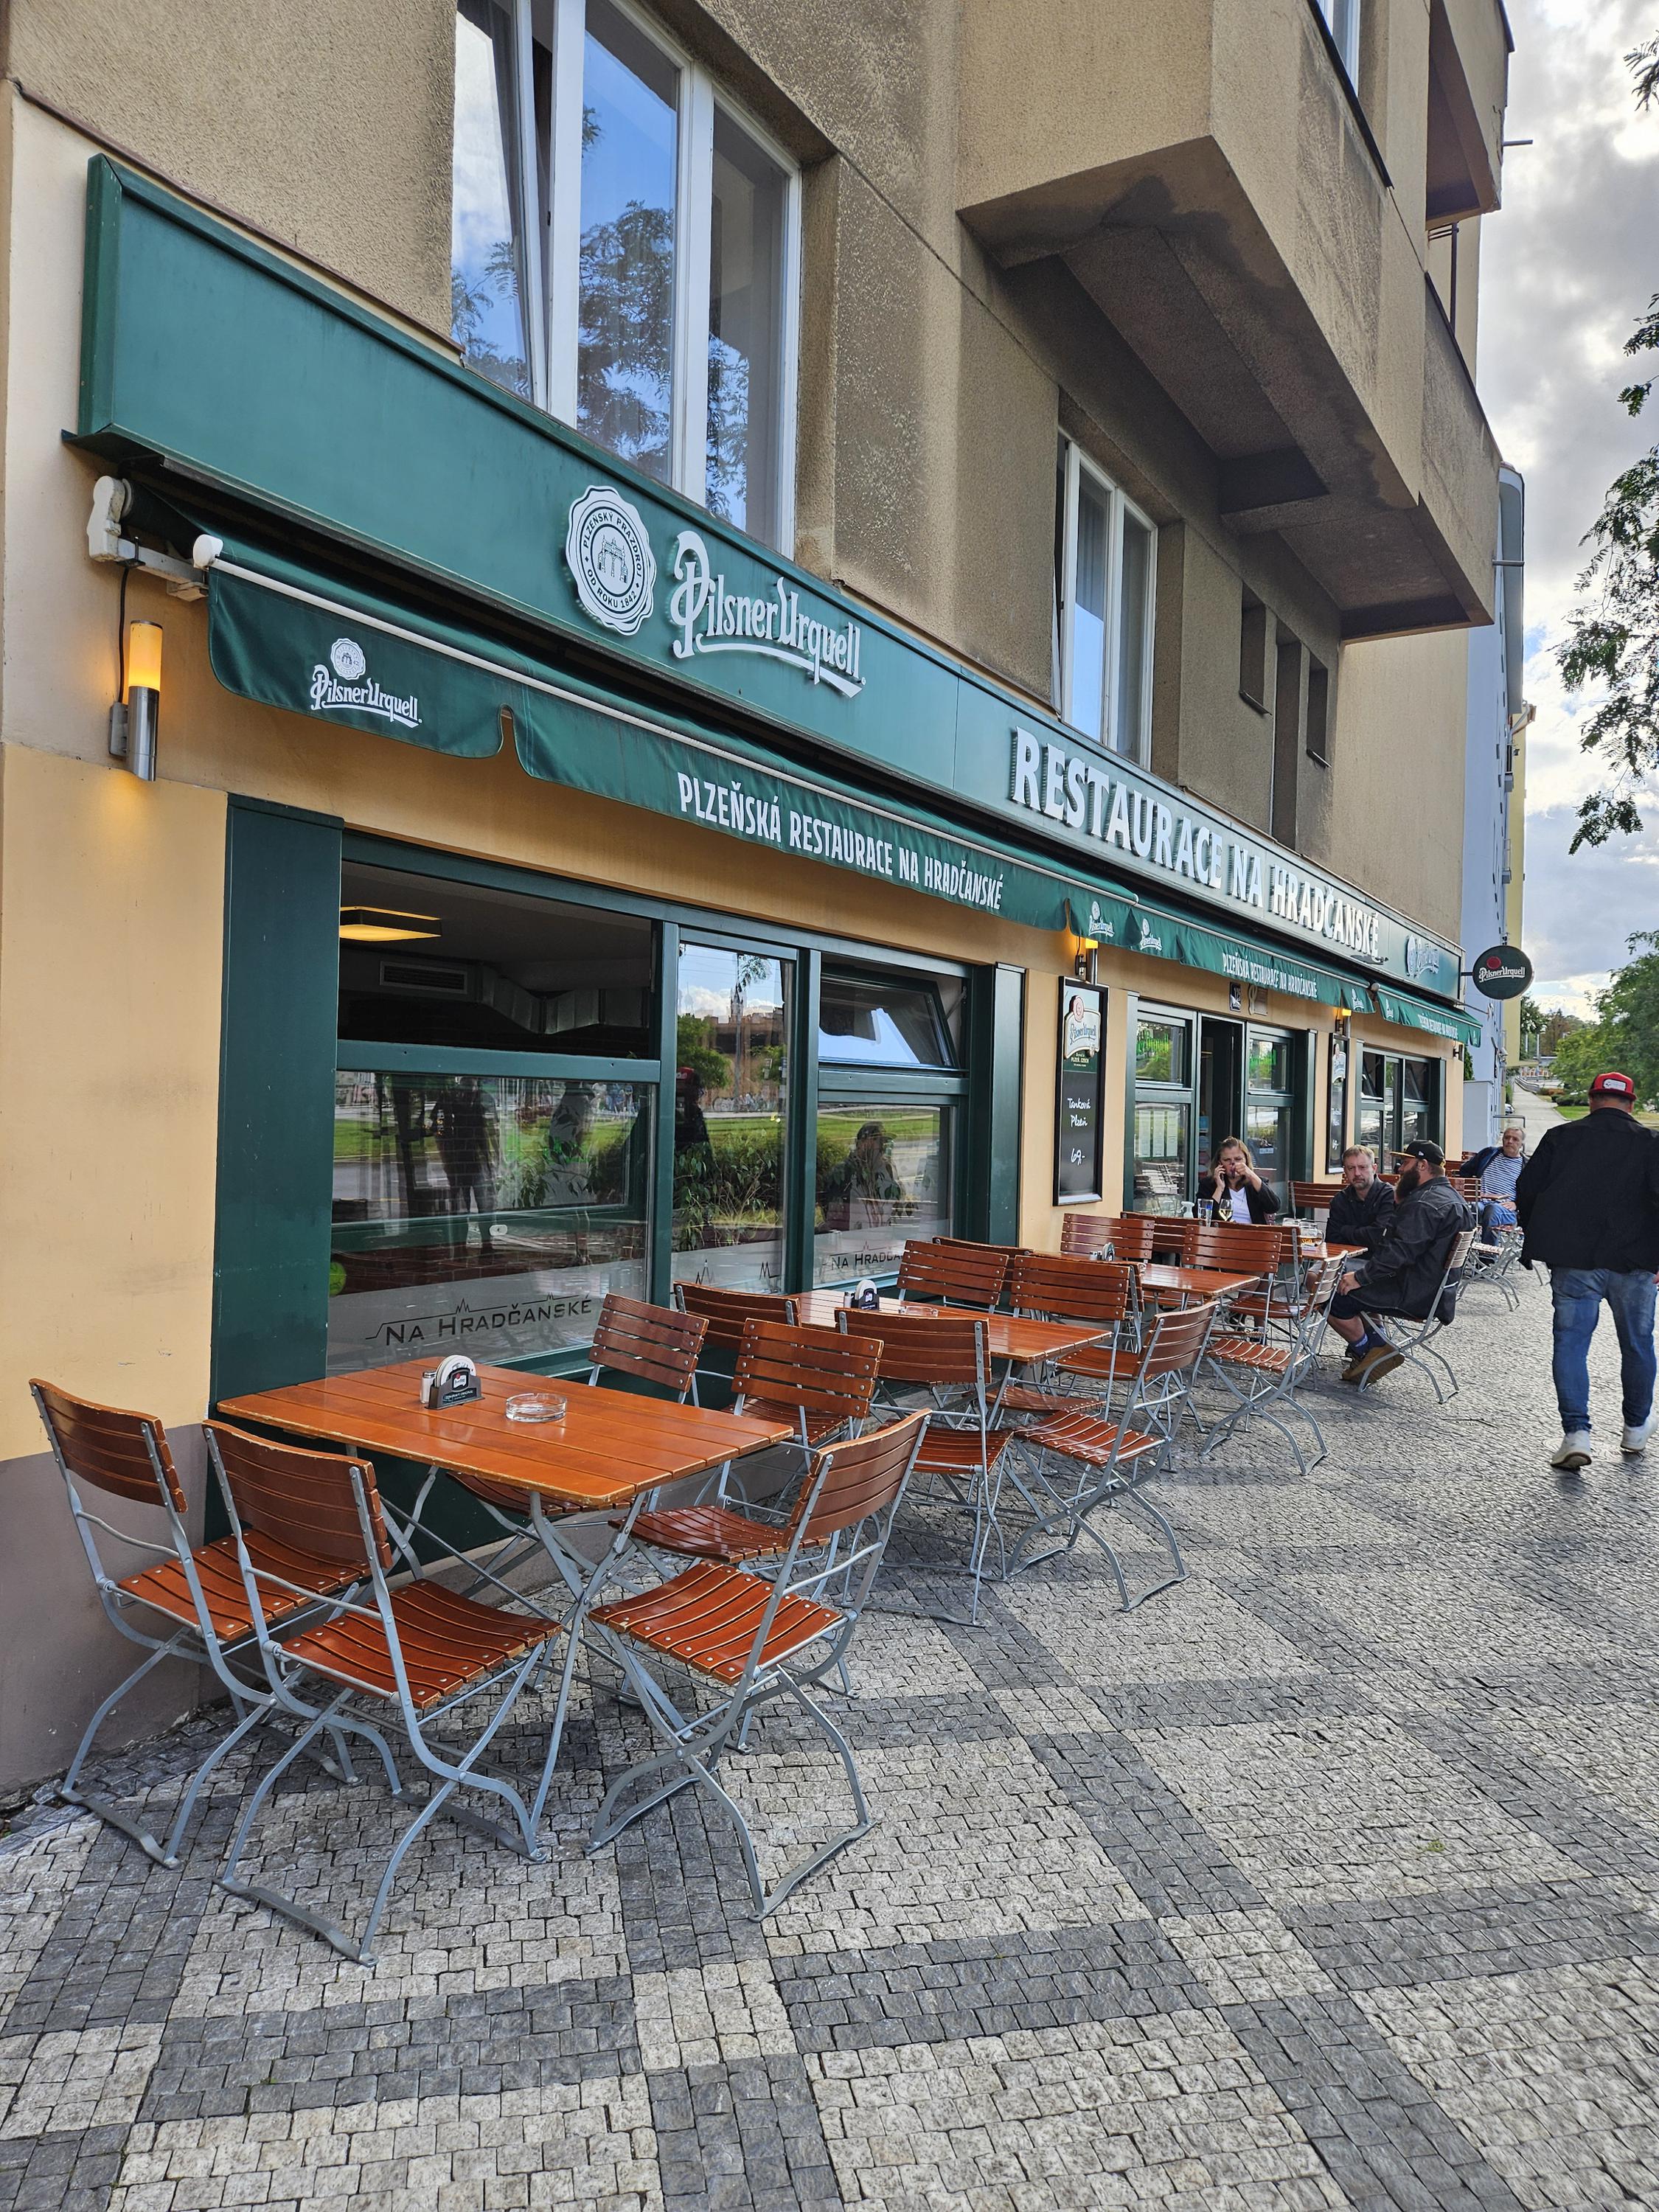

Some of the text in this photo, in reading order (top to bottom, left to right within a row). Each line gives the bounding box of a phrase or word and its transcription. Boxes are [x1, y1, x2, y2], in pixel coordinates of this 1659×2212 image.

[582, 511, 642, 577] PLZEŇSKÝ PRAZDROJ
[587, 568, 637, 608] OD ROKU 1842
[669, 530, 863, 684] Pilsner Urquell
[310, 664, 418, 723] Pilsner Urquell
[677, 771, 1004, 911] PLZEŇSKÁ RESTAURACE NA HRADČANSKÉ
[1012, 726, 1222, 890] RESTAURACE
[1231, 843, 1264, 908] NA
[1272, 864, 1379, 958] HRADČANSKÉ
[1279, 971, 1287, 990] NA
[1478, 966, 1526, 983] Pilsner Urquell
[1067, 1097, 1091, 1110] Tanková
[1070, 1114, 1088, 1127] Plzeň
[831, 1256, 849, 1270] NA
[386, 1293, 592, 1346] NA HRADČANSKÉ
